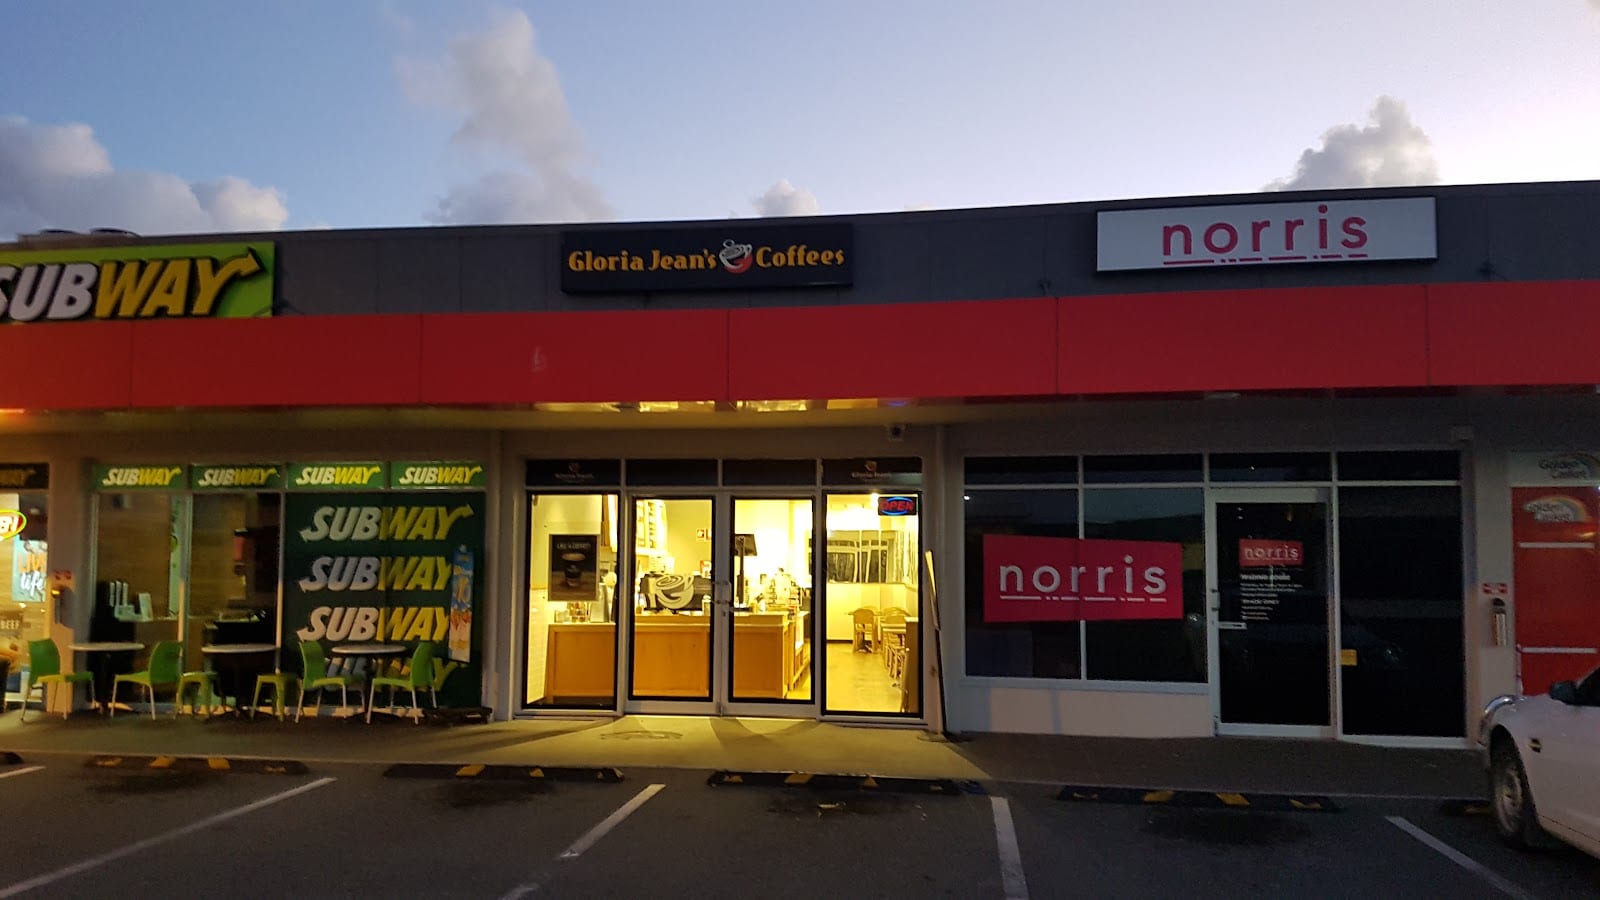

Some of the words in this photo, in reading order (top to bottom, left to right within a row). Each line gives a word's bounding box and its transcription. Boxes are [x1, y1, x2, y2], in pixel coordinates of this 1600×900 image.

[1162, 204, 1369, 256] norris
[568, 250, 644, 272] Gloria
[648, 248, 718, 270] Jean's
[755, 244, 845, 268] Coffees
[102, 467, 182, 486] SUBWAY
[198, 467, 277, 486] SUBWAY
[295, 465, 381, 485] SUBWAY
[399, 465, 482, 485] SUBWAY
[881, 500, 915, 511] OPEN
[300, 504, 474, 542] SUBWAY
[1243, 545, 1299, 559] norris
[299, 556, 451, 593] SUBWAY
[1000, 555, 1167, 595] norris
[297, 606, 449, 643] SUBWAY
